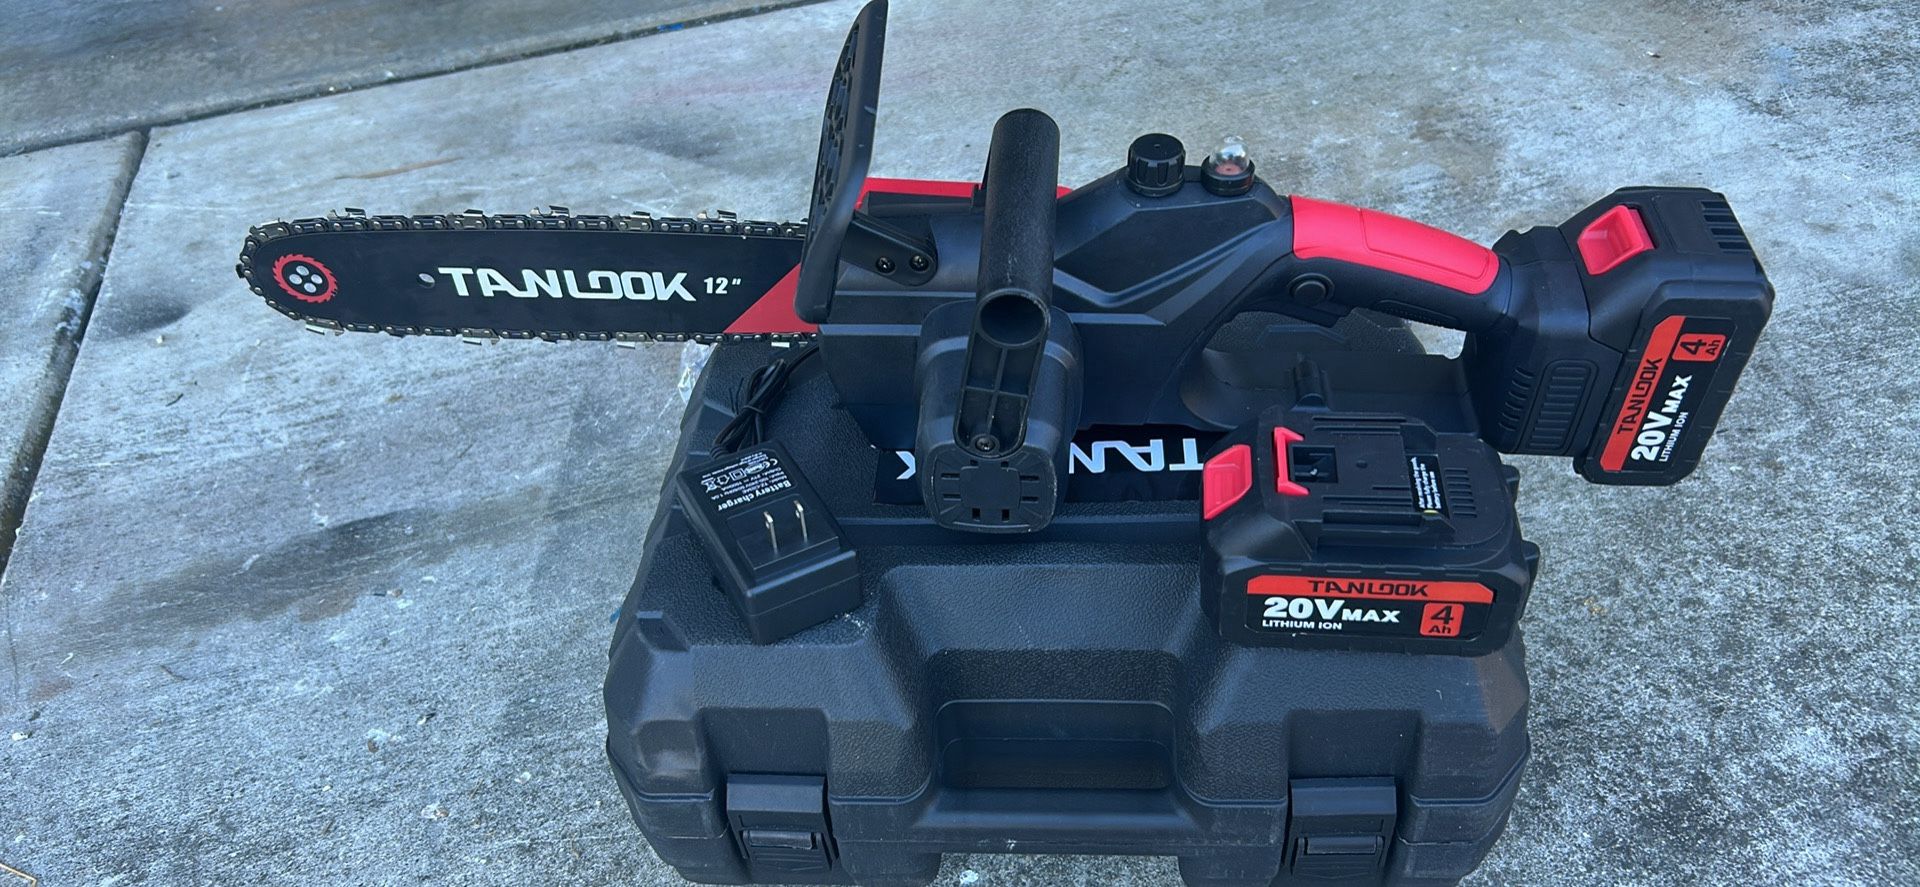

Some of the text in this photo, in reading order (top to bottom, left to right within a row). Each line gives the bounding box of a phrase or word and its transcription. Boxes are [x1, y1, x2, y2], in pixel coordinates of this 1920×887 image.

[438, 267, 697, 301] TANLOOK
[1679, 338, 1707, 355] 4
[1705, 339, 1721, 356] Ah
[1617, 358, 1663, 434] TANLOOK
[1658, 411, 1689, 462] LITHIUM ION
[755, 480, 792, 497] Battery
[718, 494, 755, 511] charger
[1308, 580, 1429, 597] TANLOOK
[1430, 605, 1454, 625] 4
[1262, 619, 1342, 630] LITHIUM ION
[1428, 624, 1451, 634] Ah
